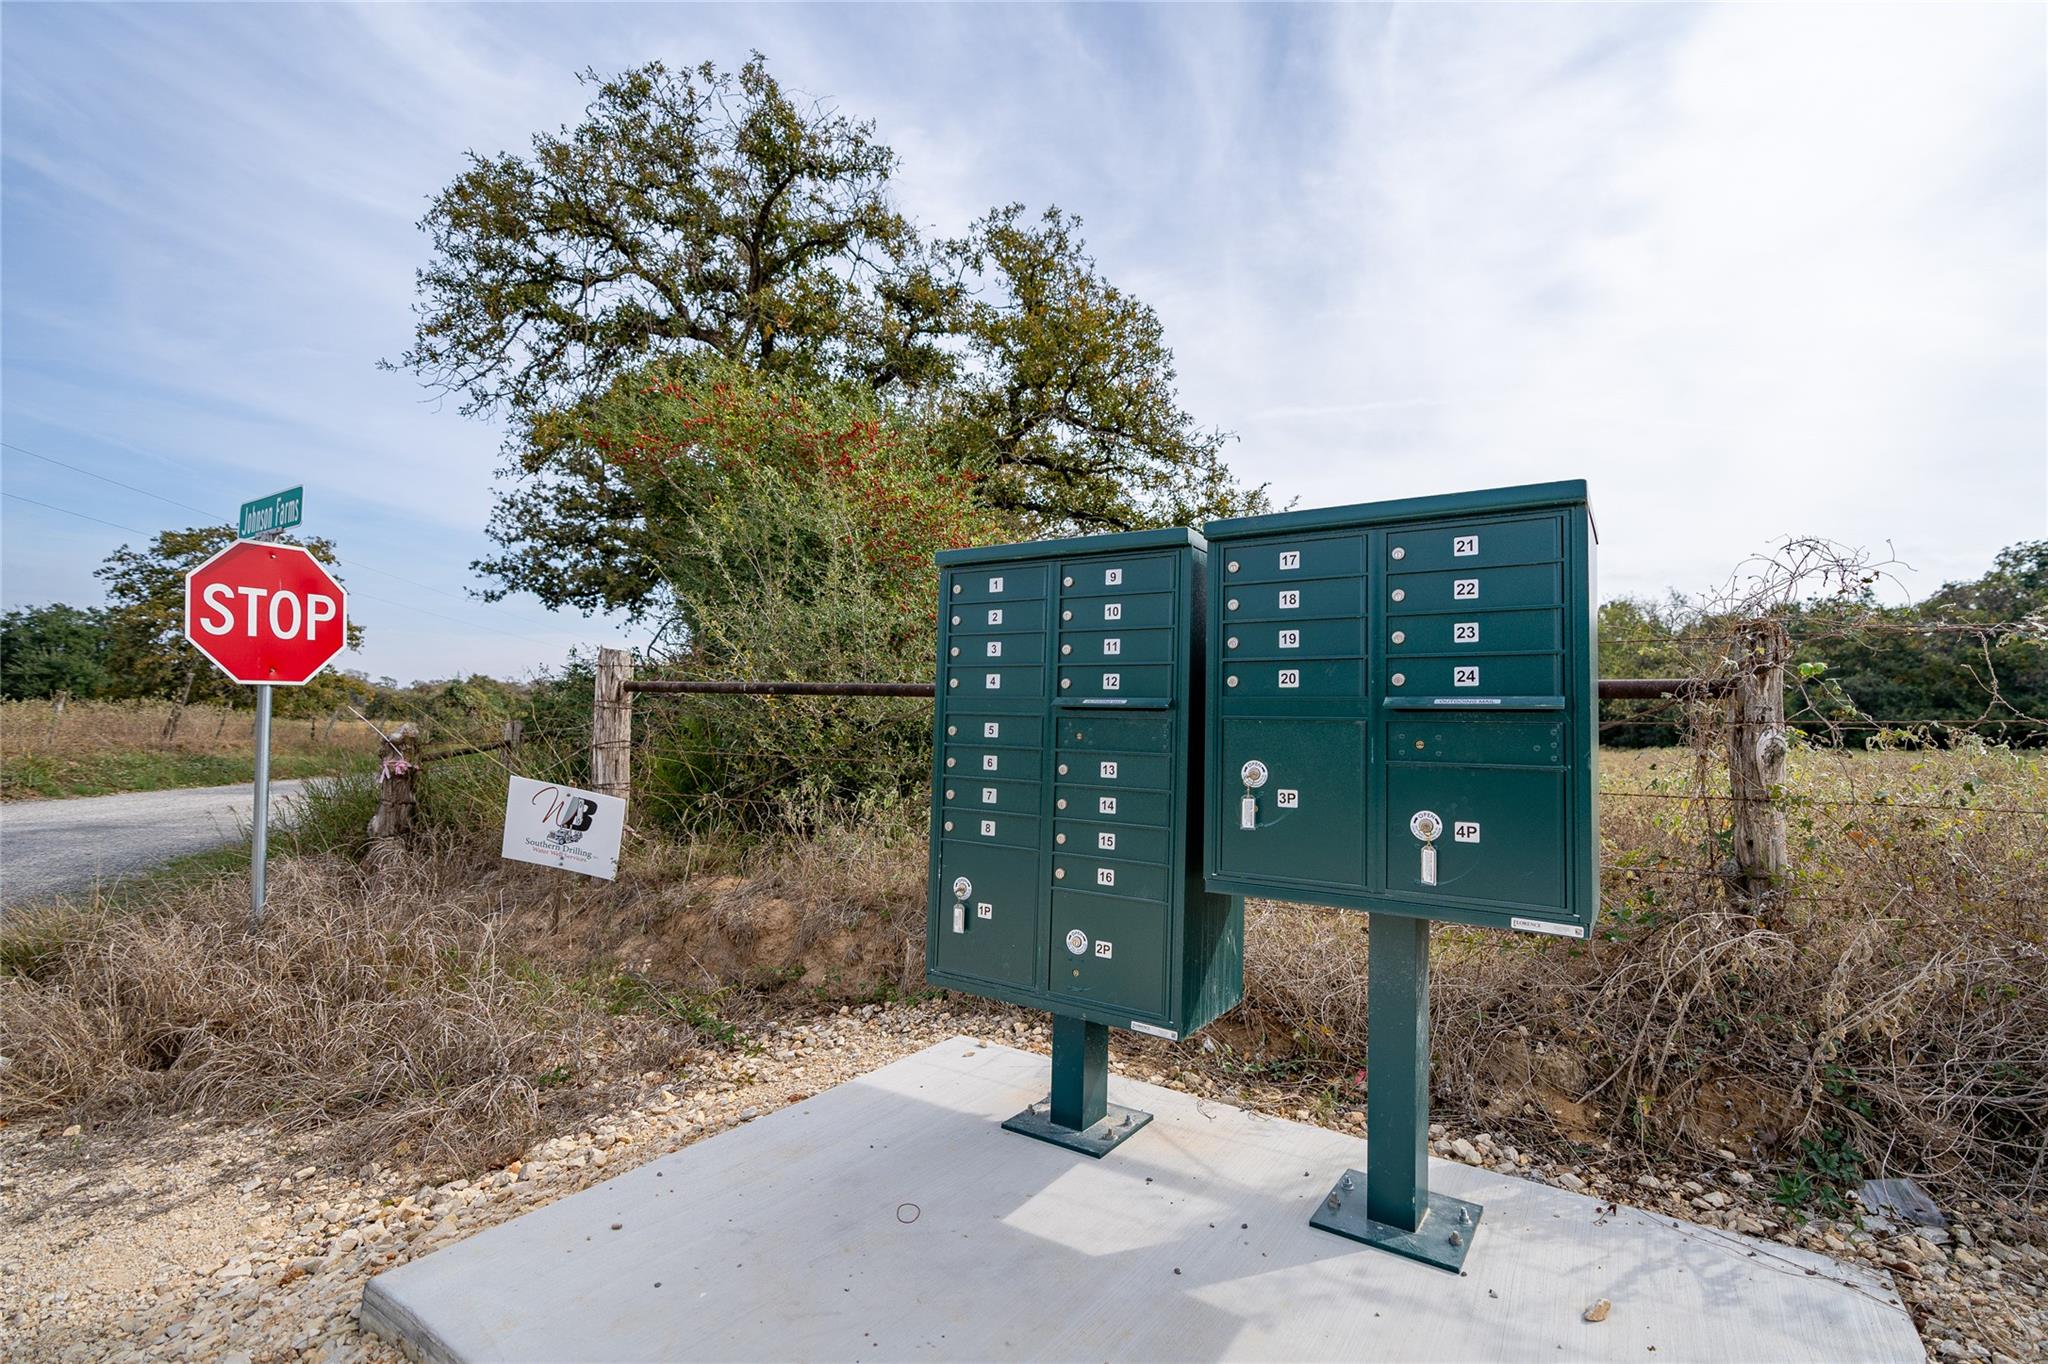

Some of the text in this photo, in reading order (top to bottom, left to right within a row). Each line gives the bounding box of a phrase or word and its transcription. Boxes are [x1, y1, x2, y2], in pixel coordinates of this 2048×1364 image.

[241, 496, 300, 536] Johnson Farms
[1456, 539, 1475, 553] 21
[1282, 554, 1297, 566] 17
[1456, 582, 1476, 596] 22
[1281, 593, 1297, 605] 18
[199, 582, 337, 641] STOP
[1107, 606, 1119, 617] 10
[1281, 632, 1297, 645] 19
[1456, 626, 1476, 639] 23
[1106, 641, 1117, 652] 11
[1105, 676, 1118, 687] 12
[1280, 672, 1297, 685] 20
[1456, 669, 1476, 683] 24
[1102, 764, 1115, 776] 13
[1279, 792, 1296, 804] 3P
[1101, 800, 1114, 811] 14
[1418, 811, 1436, 820] OPEN
[1456, 825, 1478, 839] 4P
[1100, 835, 1114, 847] 15
[524, 837, 593, 860] Southern Drilling
[1099, 871, 1113, 883] 16
[979, 905, 991, 916] 1P
[1096, 943, 1111, 955] 2P
